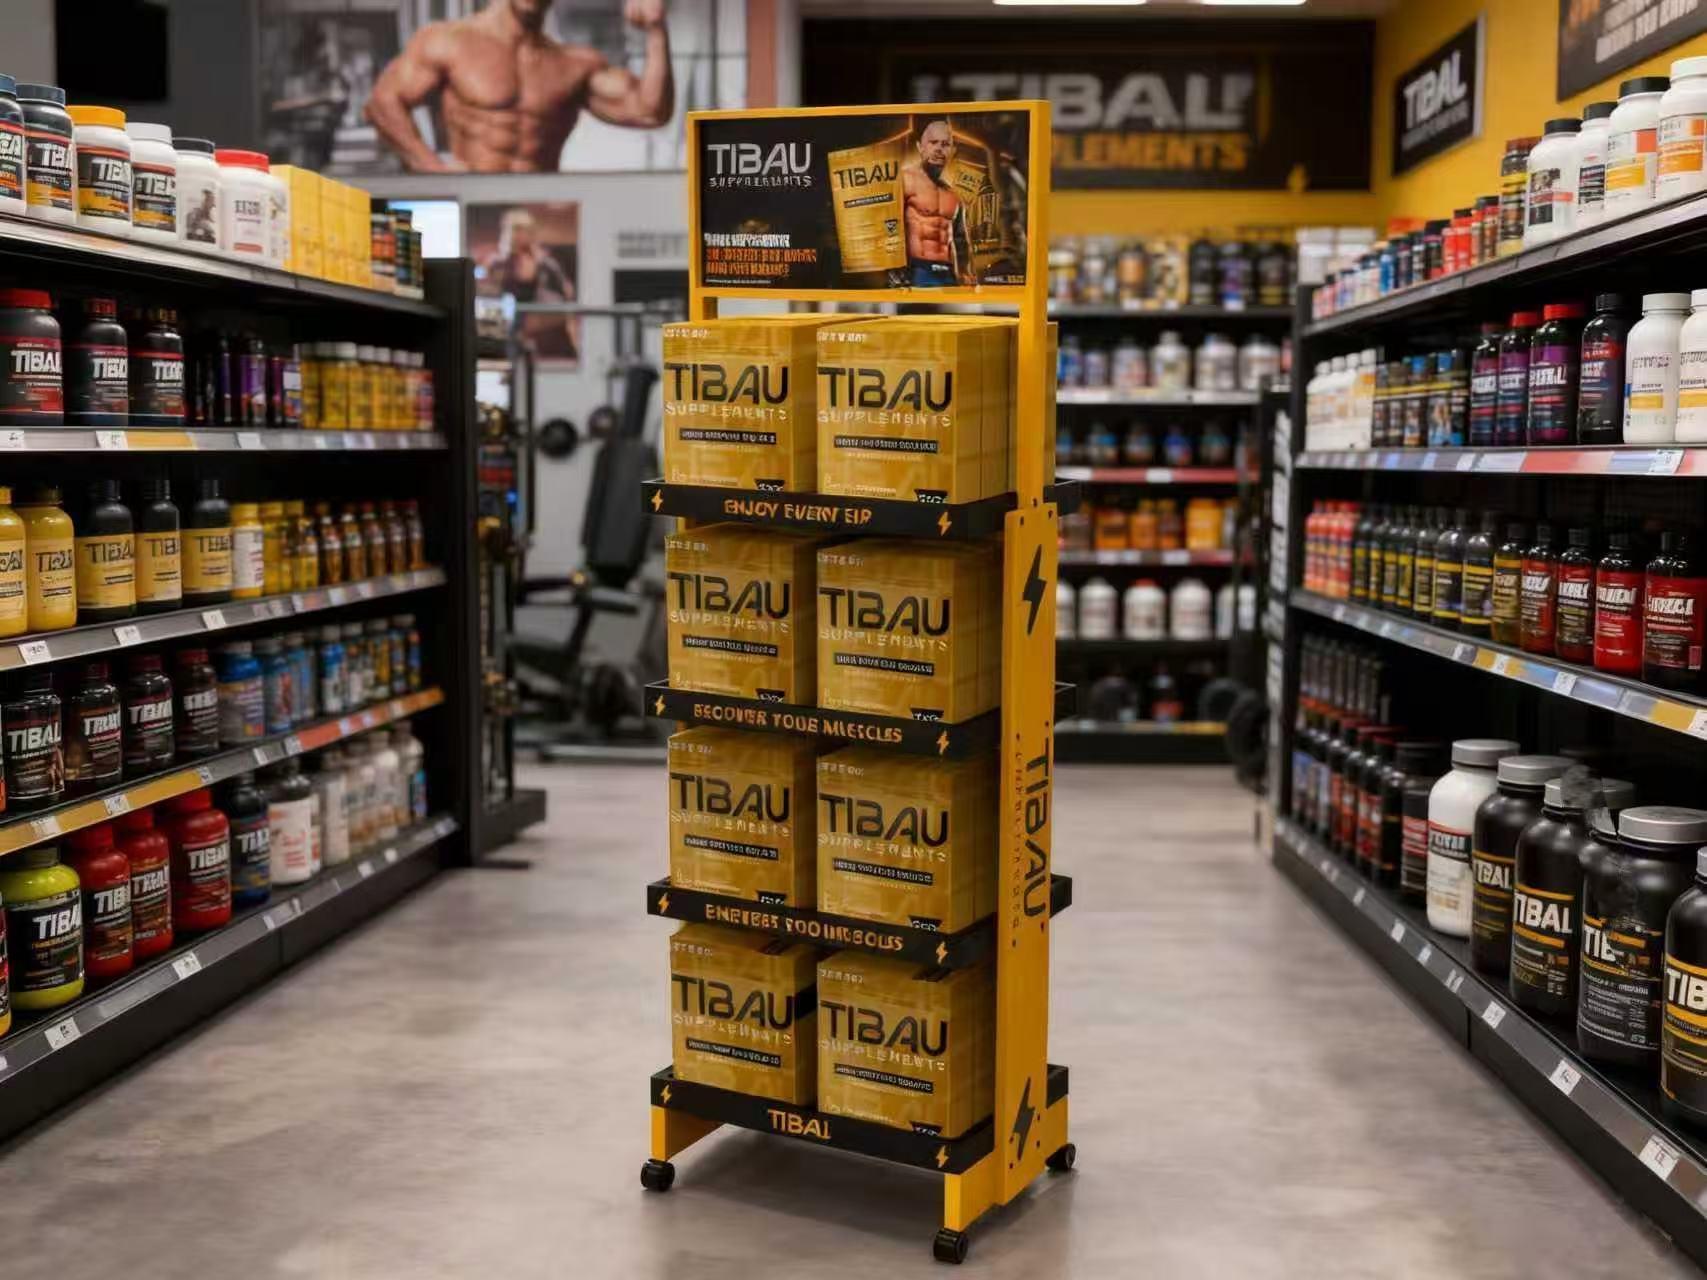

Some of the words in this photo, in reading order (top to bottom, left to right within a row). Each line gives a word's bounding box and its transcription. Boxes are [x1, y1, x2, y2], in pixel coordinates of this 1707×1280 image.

[707, 143, 811, 175] TIBAU
[833, 160, 898, 189] TIBAU
[664, 363, 788, 404] TIBAU
[818, 367, 953, 412] TIBAU
[667, 572, 790, 619] TIBAU
[819, 587, 950, 636] TIBAU
[671, 773, 790, 822] TIBAU
[819, 793, 948, 848] TIBAU
[1023, 737, 1049, 918] TIBAU
[672, 974, 794, 1030] TIBAU
[820, 1000, 948, 1057] TIBAU
